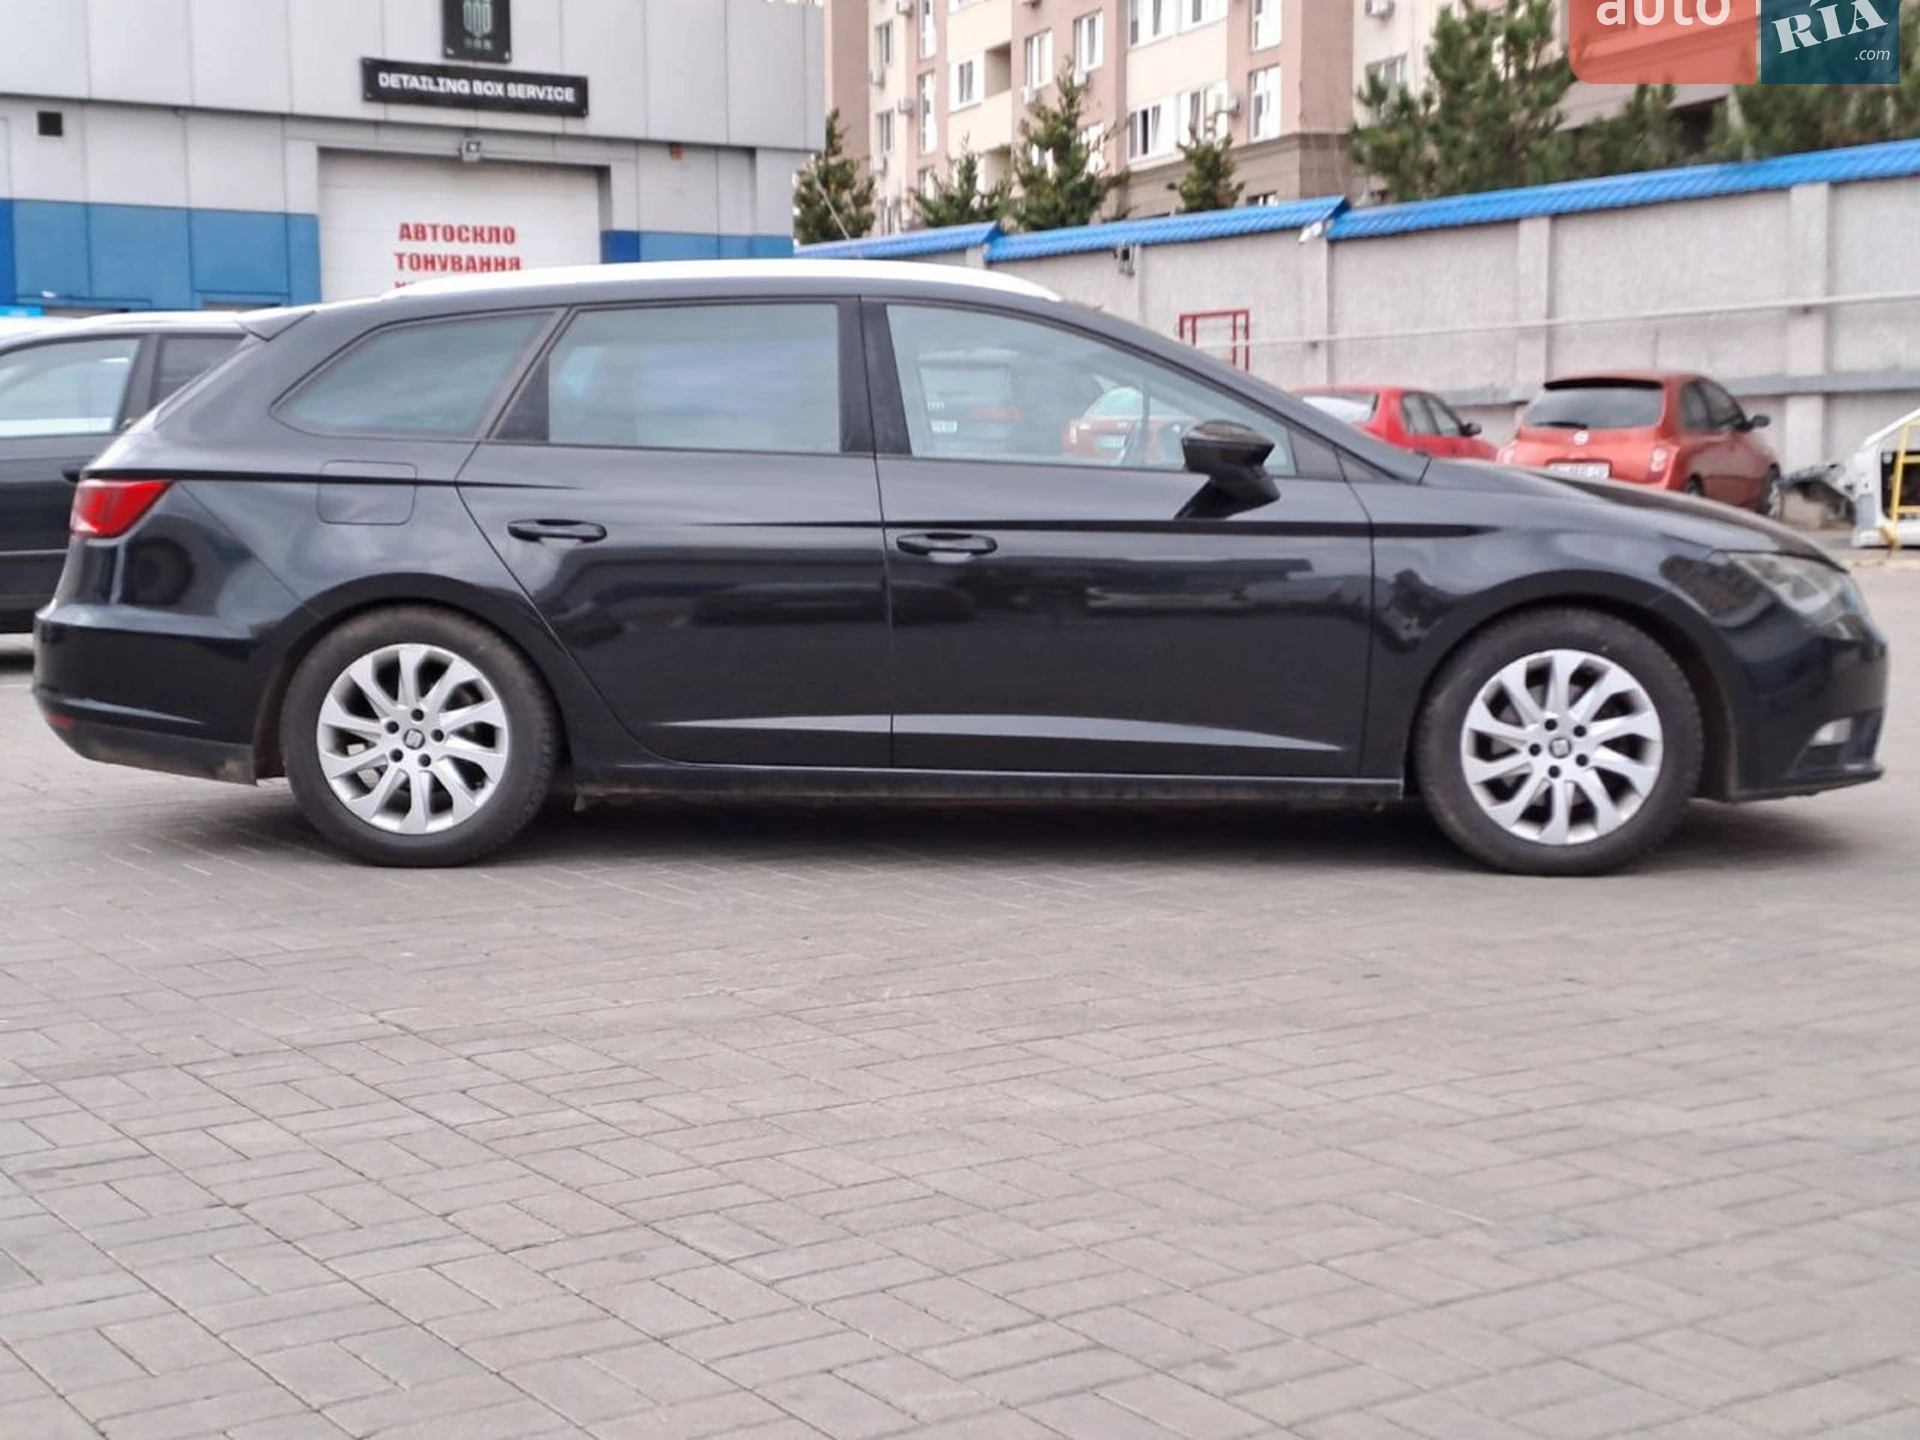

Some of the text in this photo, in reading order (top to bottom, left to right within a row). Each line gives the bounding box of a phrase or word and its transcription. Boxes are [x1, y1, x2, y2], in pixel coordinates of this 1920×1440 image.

[377, 72, 575, 102] DETAILING BOX SERVICE
[399, 222, 516, 245] АВТОСКЛО
[394, 252, 521, 272] ТОНУВАННЯ
